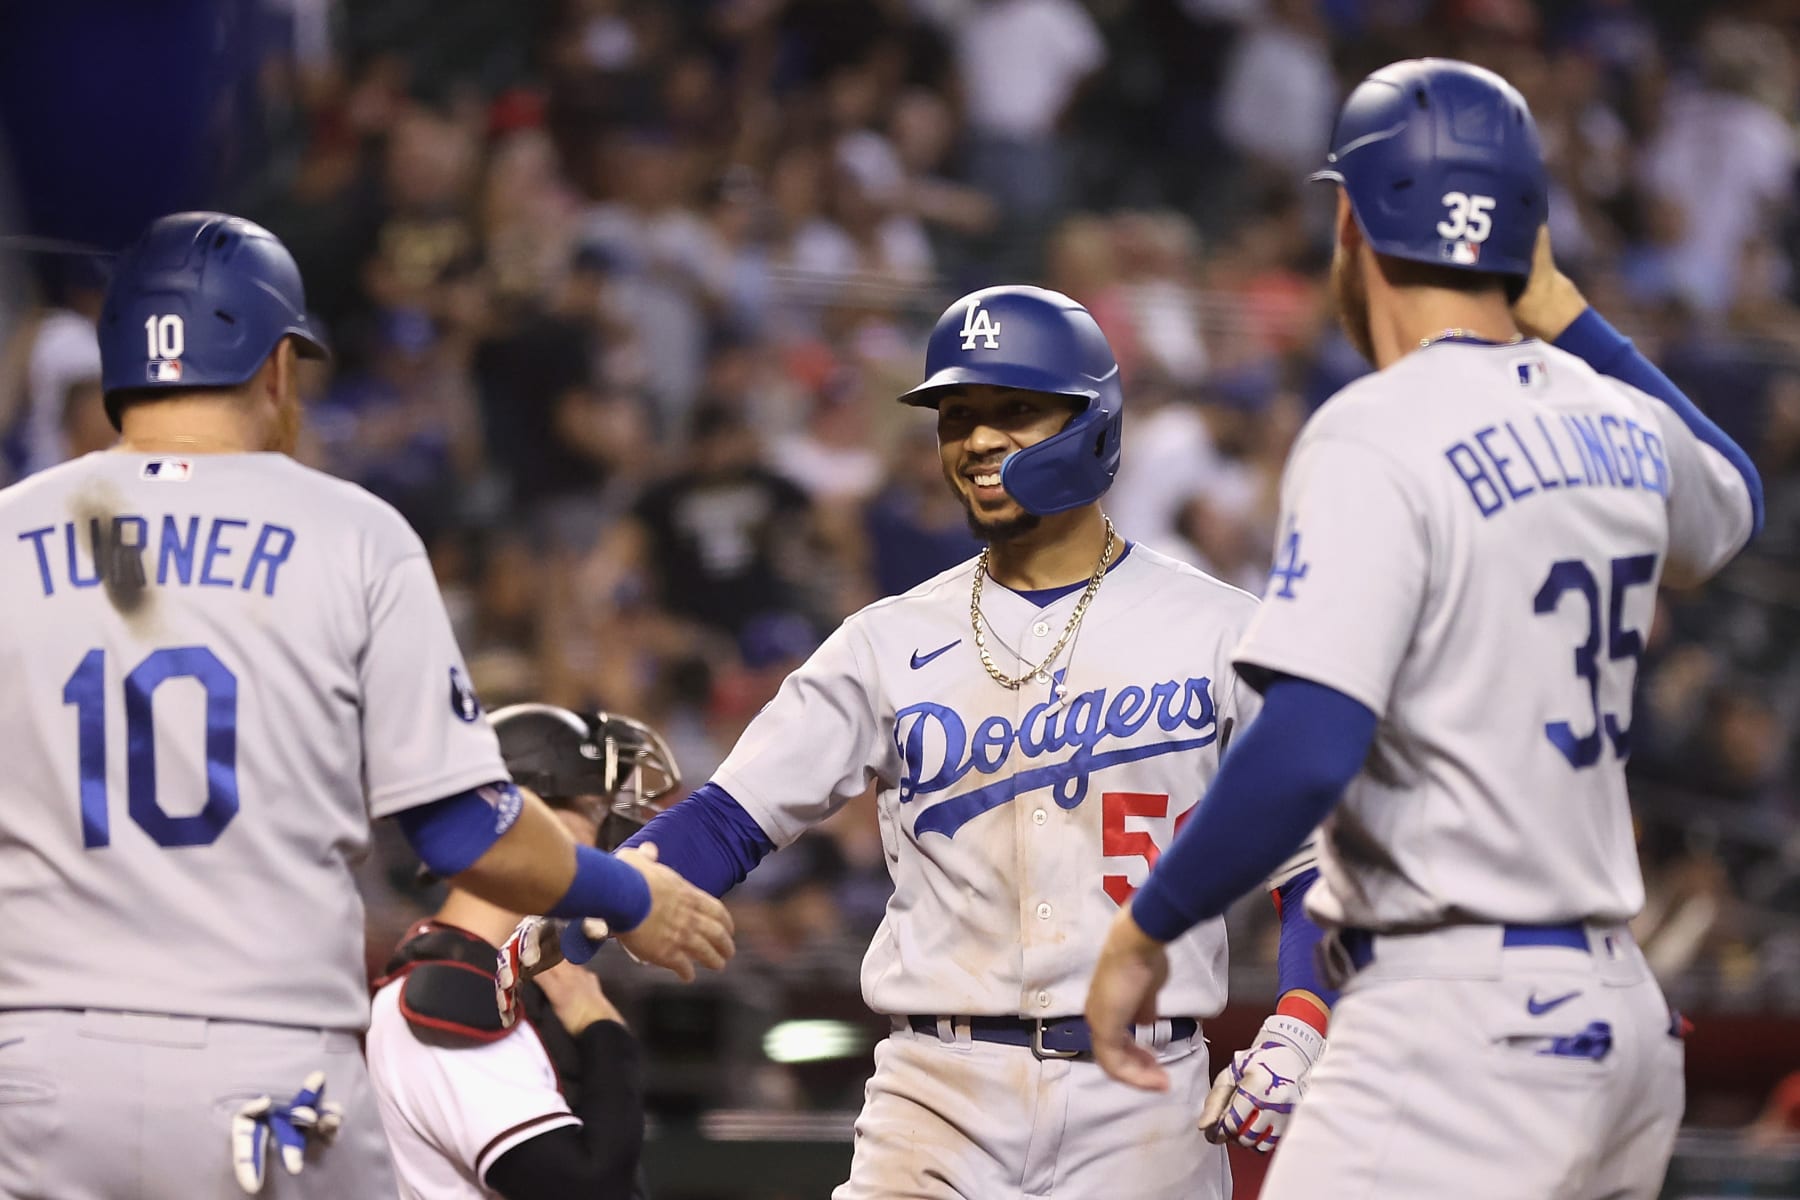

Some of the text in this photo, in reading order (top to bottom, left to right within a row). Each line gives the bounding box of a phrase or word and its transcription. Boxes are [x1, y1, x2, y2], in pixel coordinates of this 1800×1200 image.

[1437, 192, 1496, 243] 35
[145, 314, 184, 359] 10
[959, 299, 1001, 350] LA
[1445, 413, 1668, 518] BELLINGER
[18, 514, 296, 597] TURNER
[1533, 553, 1657, 770] 35
[62, 645, 239, 848] 10
[894, 668, 1217, 809] Dodgers
[1102, 792, 1199, 907] 5
